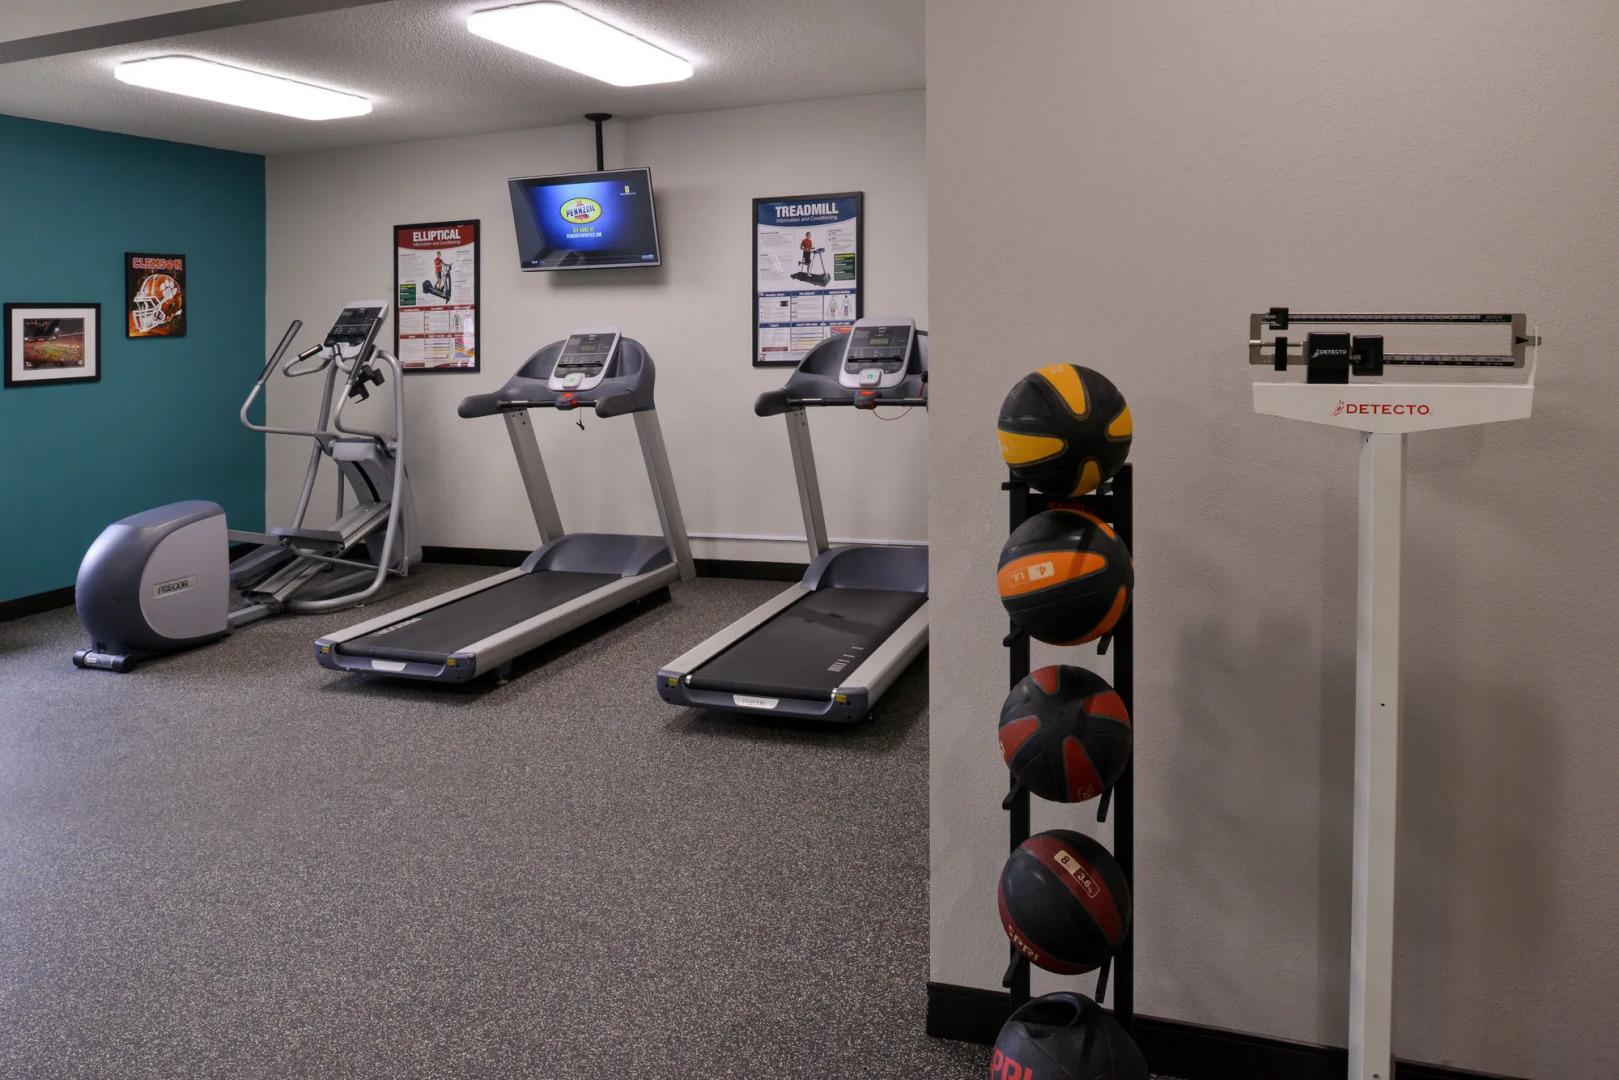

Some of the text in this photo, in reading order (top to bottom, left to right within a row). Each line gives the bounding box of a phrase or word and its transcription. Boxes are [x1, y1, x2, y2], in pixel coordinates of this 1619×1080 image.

[775, 202, 838, 217] TREADMILL
[810, 214, 838, 222] Conditioning
[412, 228, 461, 242] ELLIPTICAL
[1346, 403, 1430, 415] DETECTO
[157, 580, 189, 595] PRECOR
[1060, 855, 1071, 864] 8
[1008, 924, 1040, 962] SPRI
